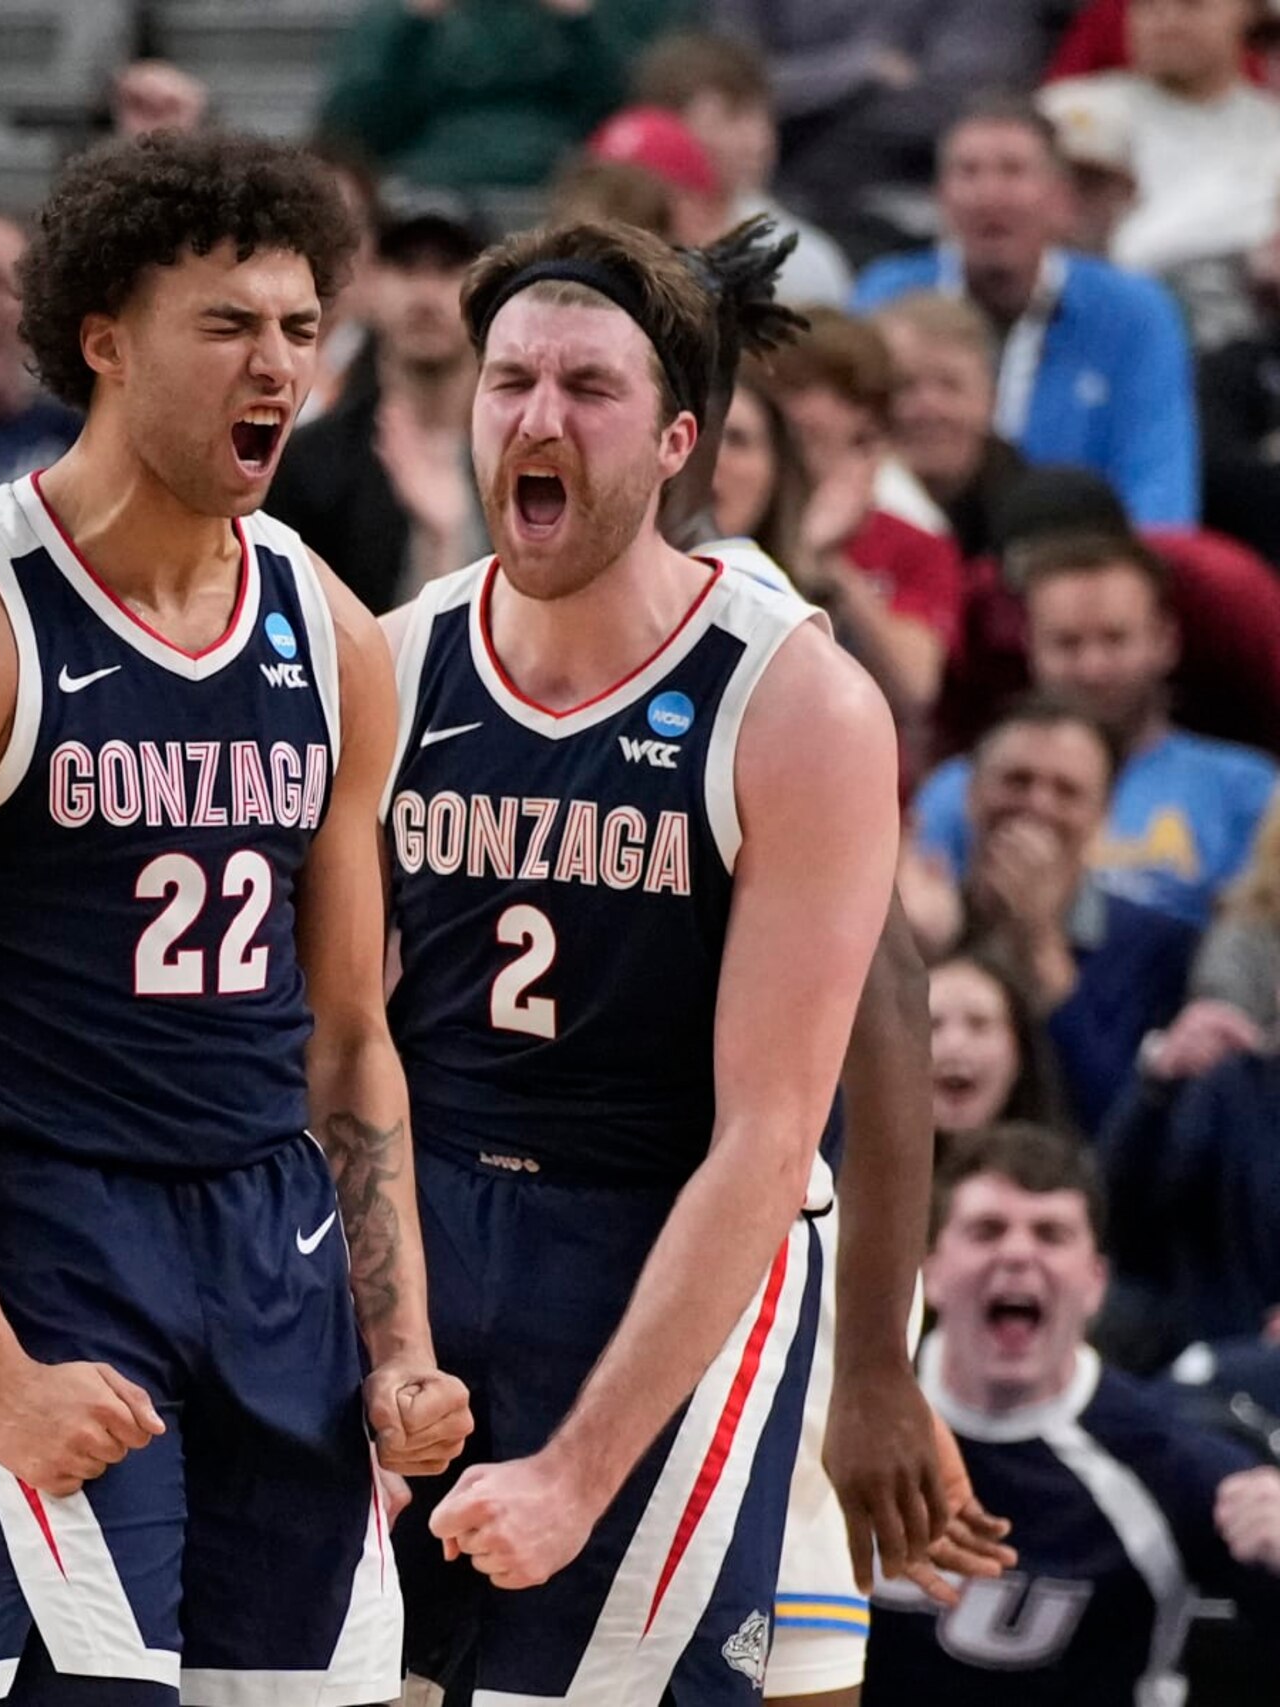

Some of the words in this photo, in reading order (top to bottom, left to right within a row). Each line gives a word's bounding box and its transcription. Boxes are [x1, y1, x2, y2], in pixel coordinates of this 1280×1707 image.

[260, 663, 309, 689] WCC
[48, 740, 327, 829] GONZAGA
[618, 736, 681, 769] WCC
[392, 790, 691, 896] GONZAGA
[135, 849, 273, 996] 22
[490, 903, 557, 1040] 2
